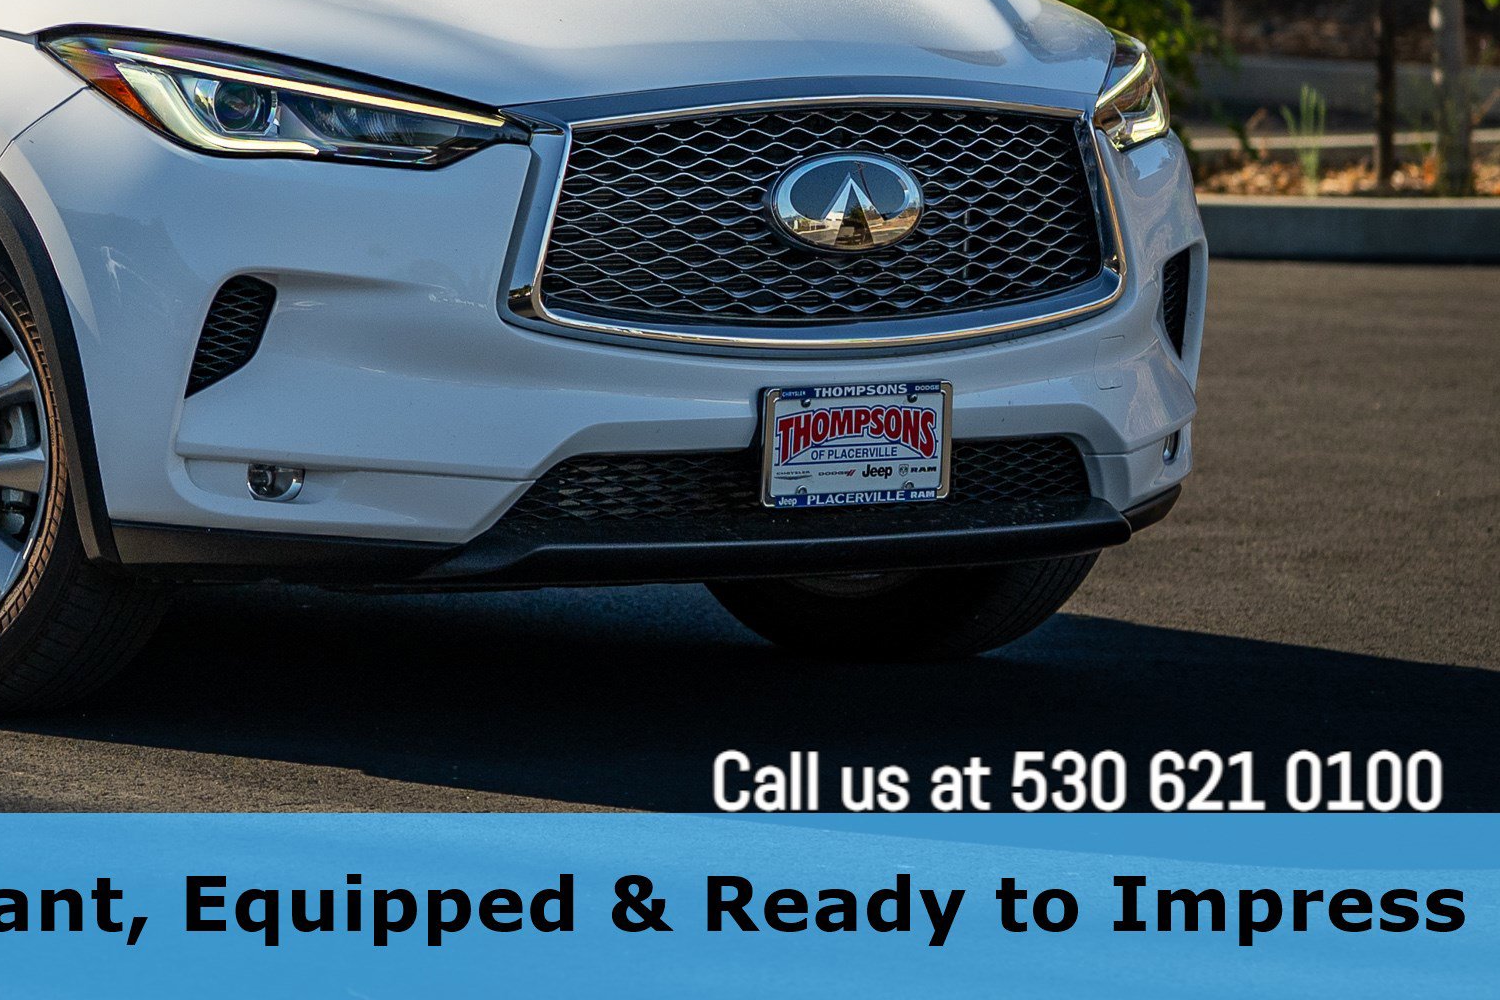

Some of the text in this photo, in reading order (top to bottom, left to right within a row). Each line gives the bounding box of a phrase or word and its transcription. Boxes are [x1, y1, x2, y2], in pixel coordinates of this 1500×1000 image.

[814, 383, 908, 398] THOMPSONS
[779, 407, 935, 464] THOMPSONS
[811, 447, 898, 460] OF PLACERVILLE
[862, 464, 893, 480] Jeep
[778, 490, 936, 507] Jeep PLACERVILLE RAM
